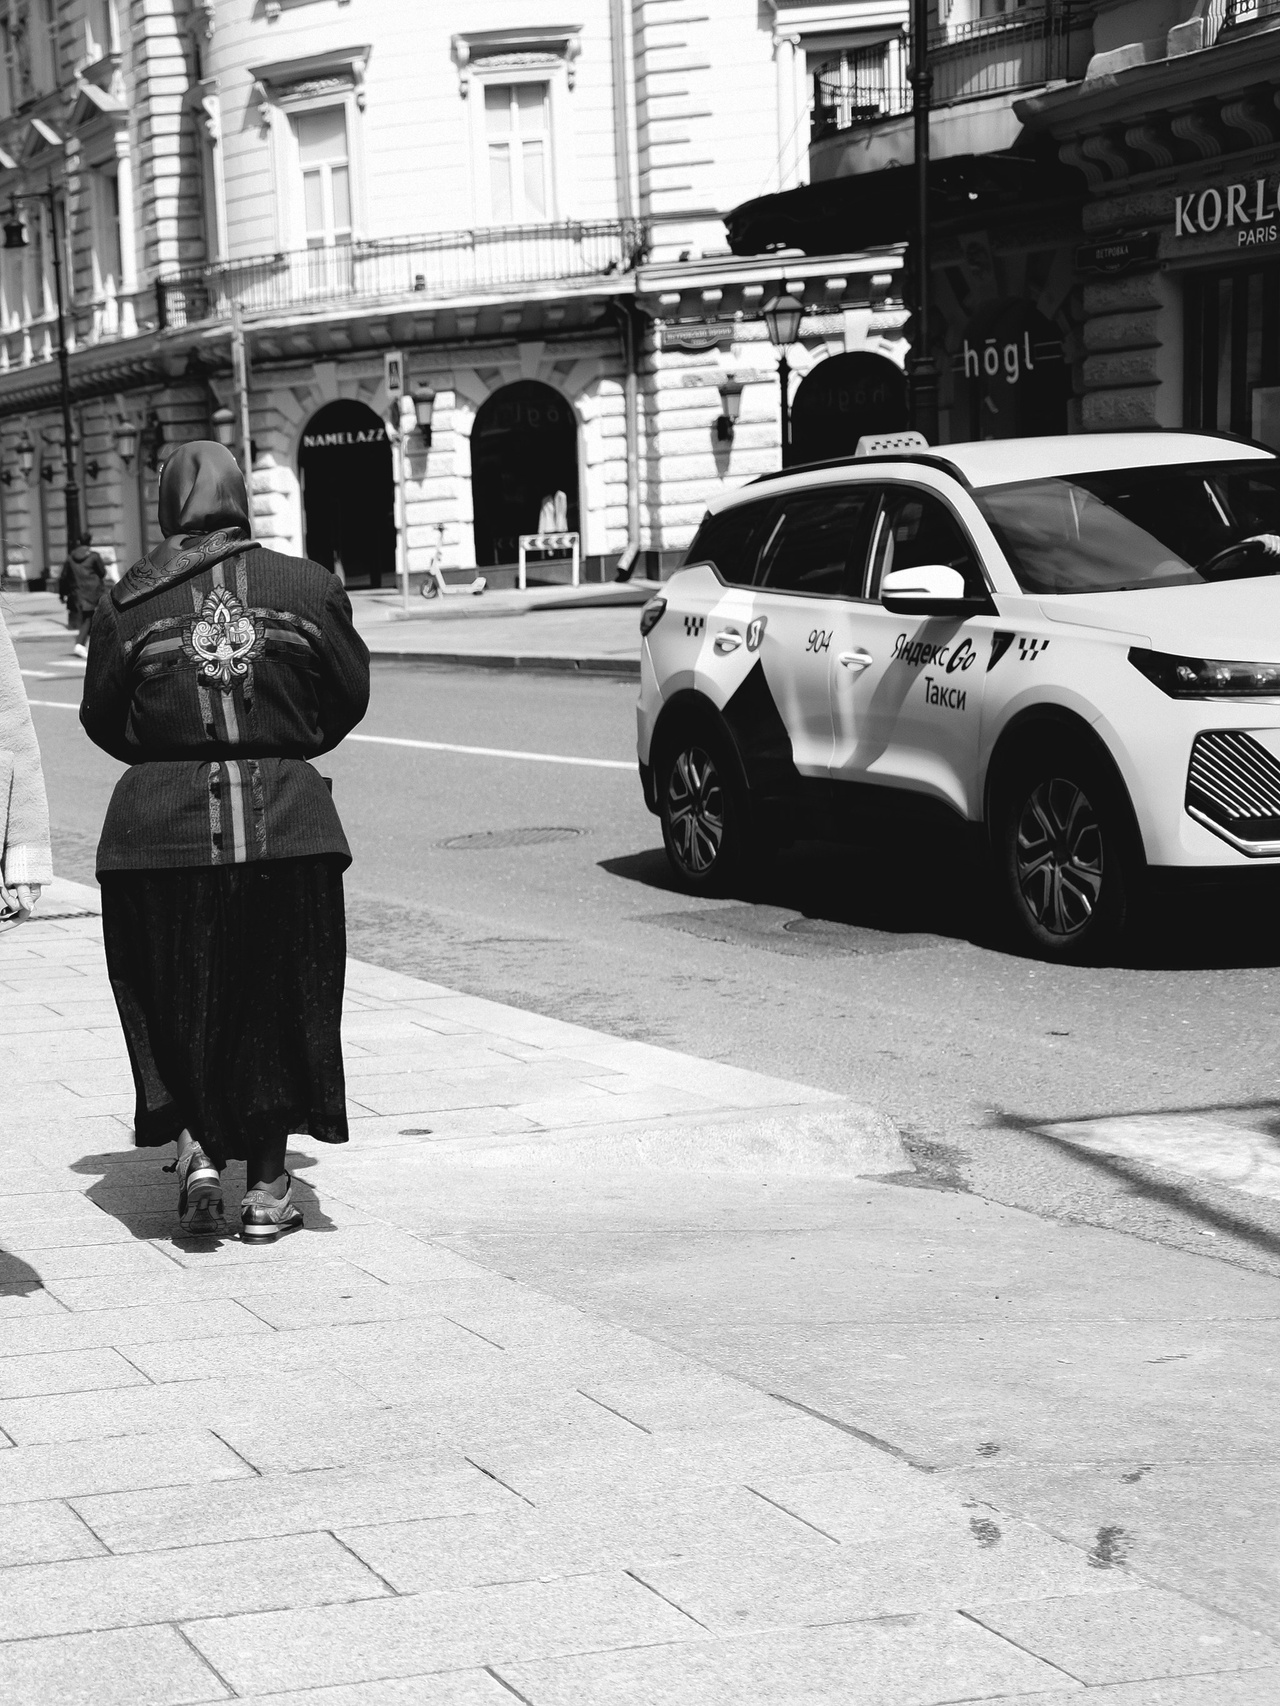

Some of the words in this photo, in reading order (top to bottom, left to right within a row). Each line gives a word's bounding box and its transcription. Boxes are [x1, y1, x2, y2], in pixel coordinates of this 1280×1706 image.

[1175, 179, 1280, 236] KORL
[1238, 225, 1277, 247] PARIS
[303, 427, 385, 448] NAMELAZZ
[805, 629, 834, 653] 904
[891, 633, 950, 667] Яндекс
[946, 637, 977, 674] Go
[924, 676, 967, 711] Такси
